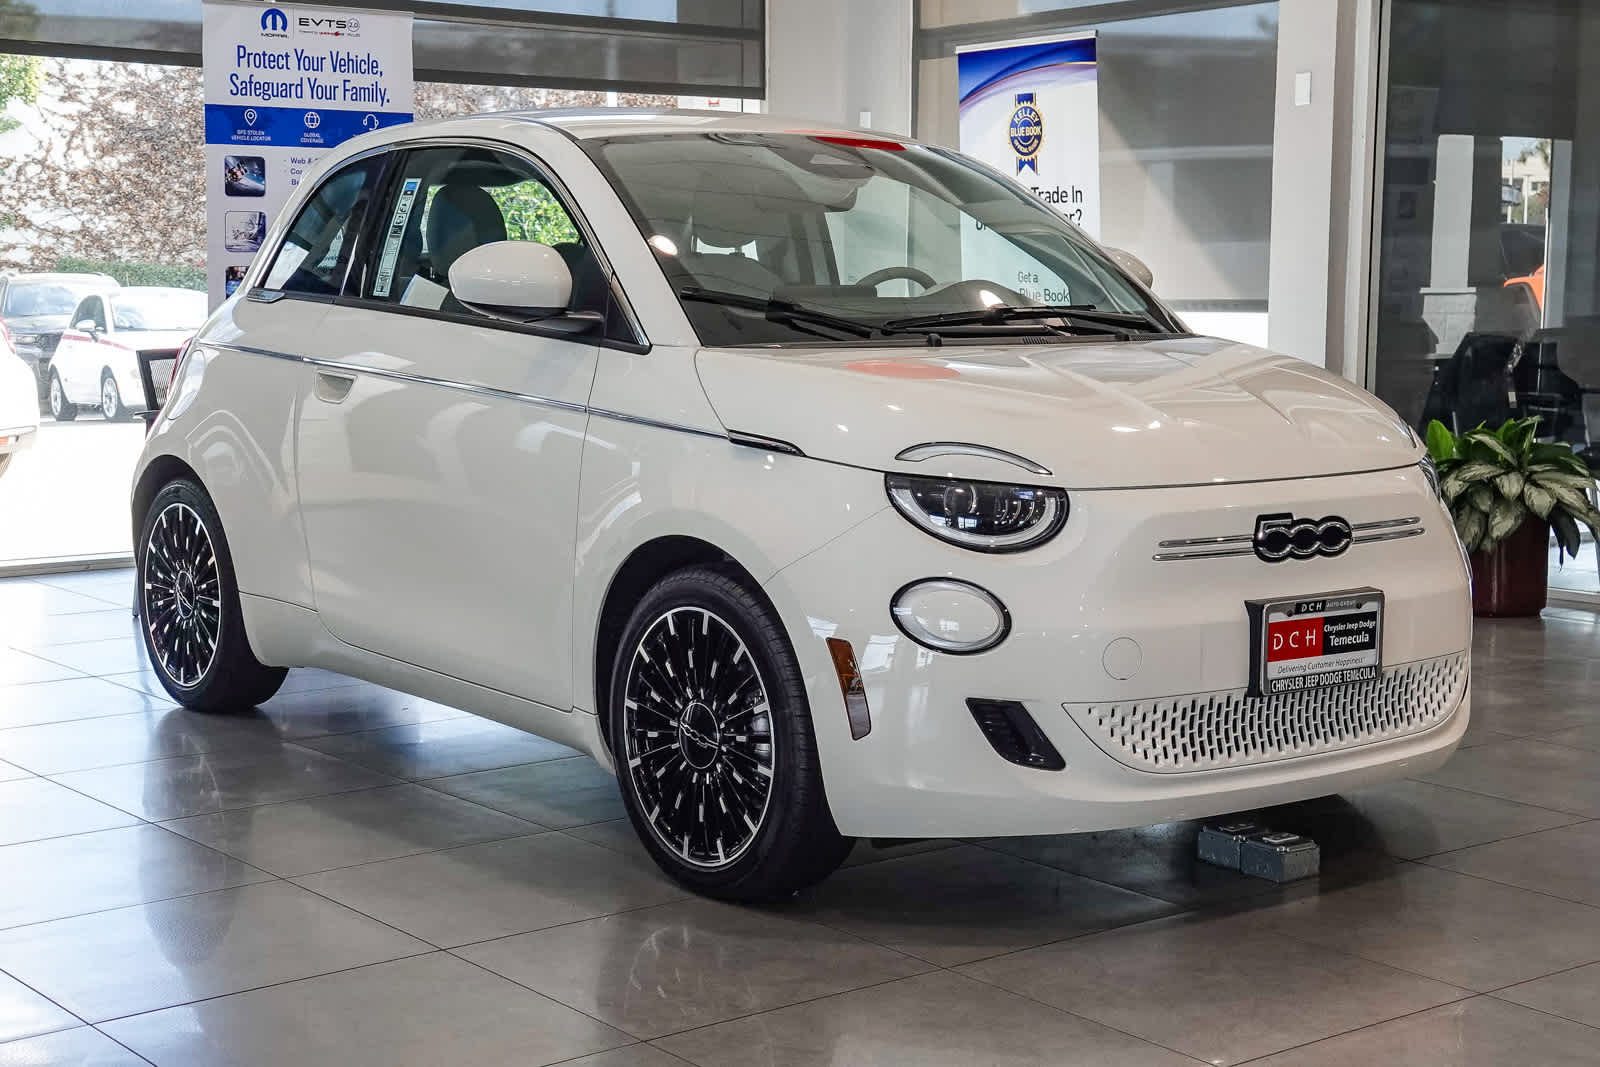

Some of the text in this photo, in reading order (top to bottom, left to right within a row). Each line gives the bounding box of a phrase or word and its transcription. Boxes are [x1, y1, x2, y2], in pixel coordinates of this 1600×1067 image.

[298, 17, 347, 29] EVTS
[236, 45, 383, 77] Protect Your Vehicle,
[229, 73, 391, 107] Safeguard Your Family.
[1013, 107, 1040, 124] KELLEY
[1010, 126, 1042, 137] BLUE BOOK
[290, 157, 306, 165] Web
[1072, 185, 1083, 203] In
[1017, 271, 1039, 283] Get a
[1043, 288, 1069, 302] Book
[1254, 513, 1352, 562] 500
[1301, 601, 1323, 612] DCH
[1323, 619, 1377, 633] Chrysler Jeep Dodge
[1272, 628, 1317, 651] DCH
[1329, 631, 1370, 648] Temecula
[1277, 663, 1307, 674] Delivering
[1307, 659, 1335, 669] Customer
[1271, 666, 1377, 693] CHRYSLER JEEP DODGE TEMECULA
